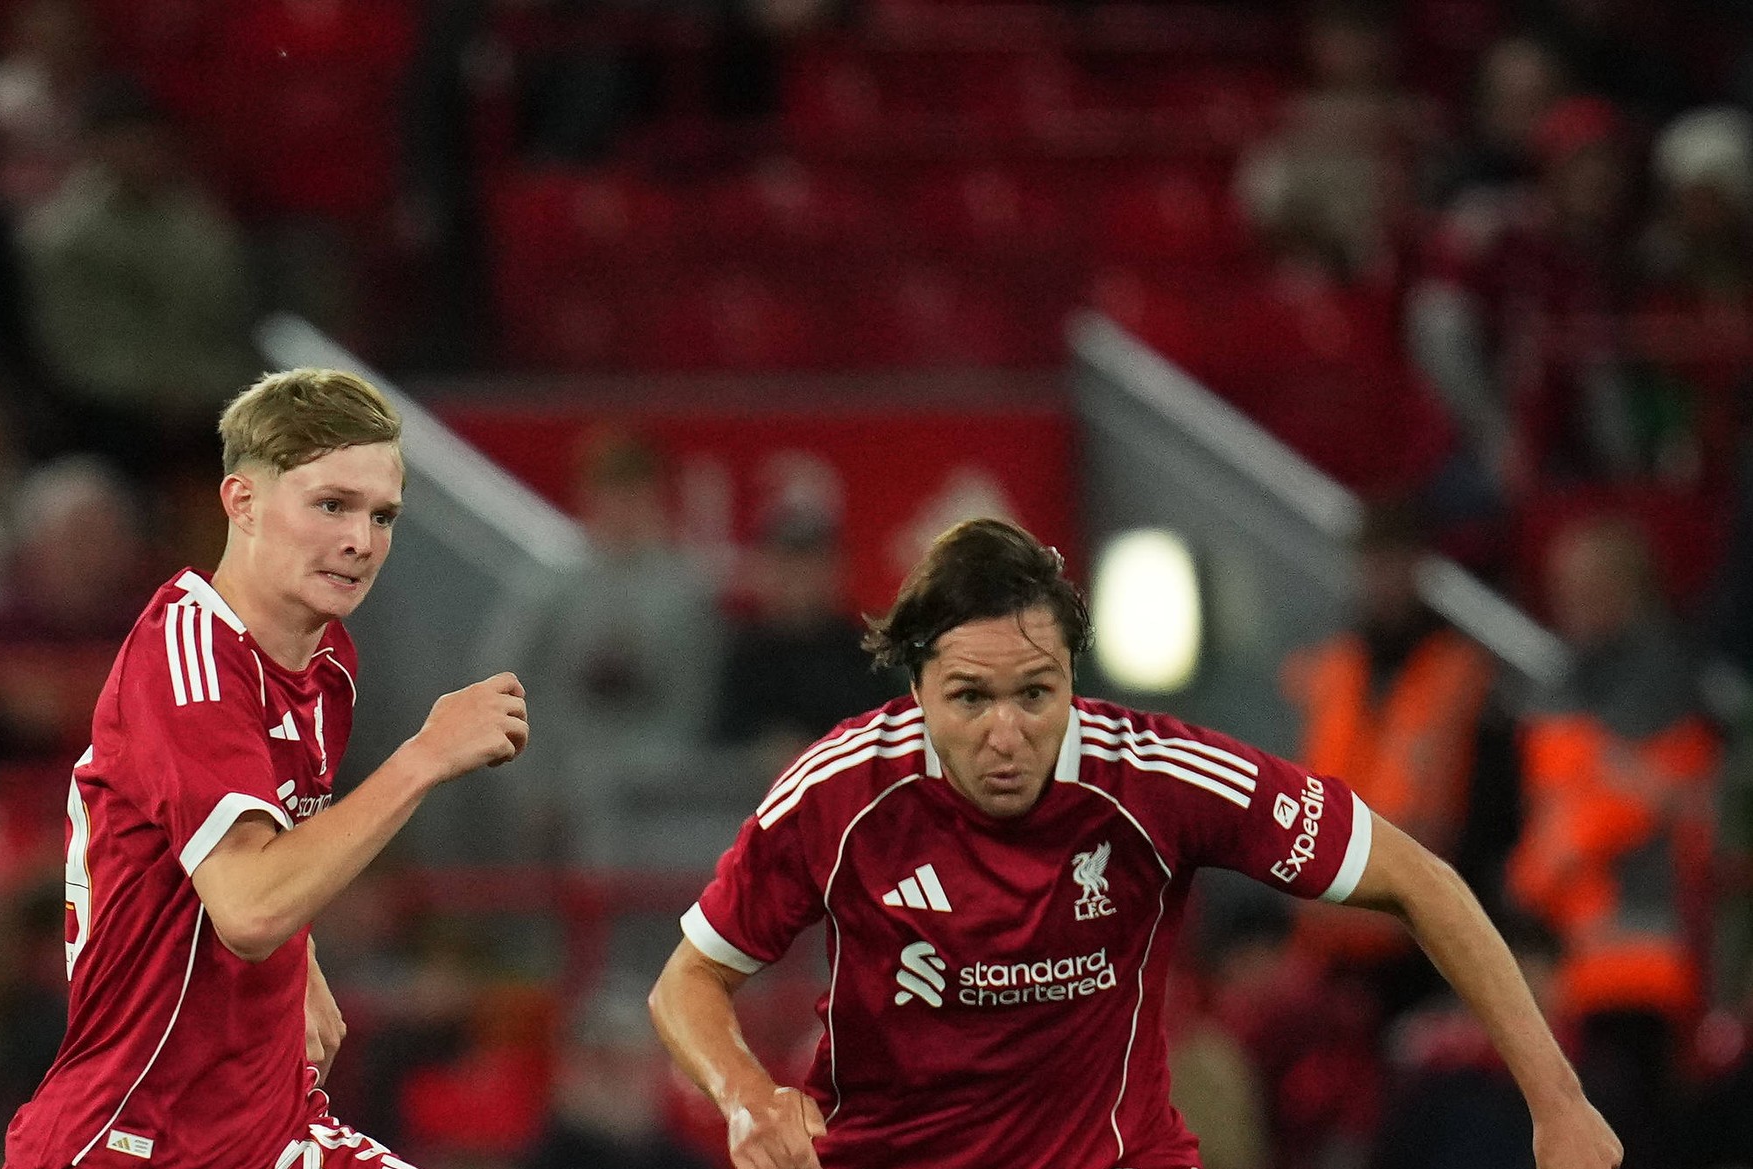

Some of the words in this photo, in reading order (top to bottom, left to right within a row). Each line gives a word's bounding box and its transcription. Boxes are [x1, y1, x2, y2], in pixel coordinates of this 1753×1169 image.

[1270, 775, 1325, 883] Expedia
[958, 963, 1117, 1006] chartered
[959, 946, 1107, 987] standard
